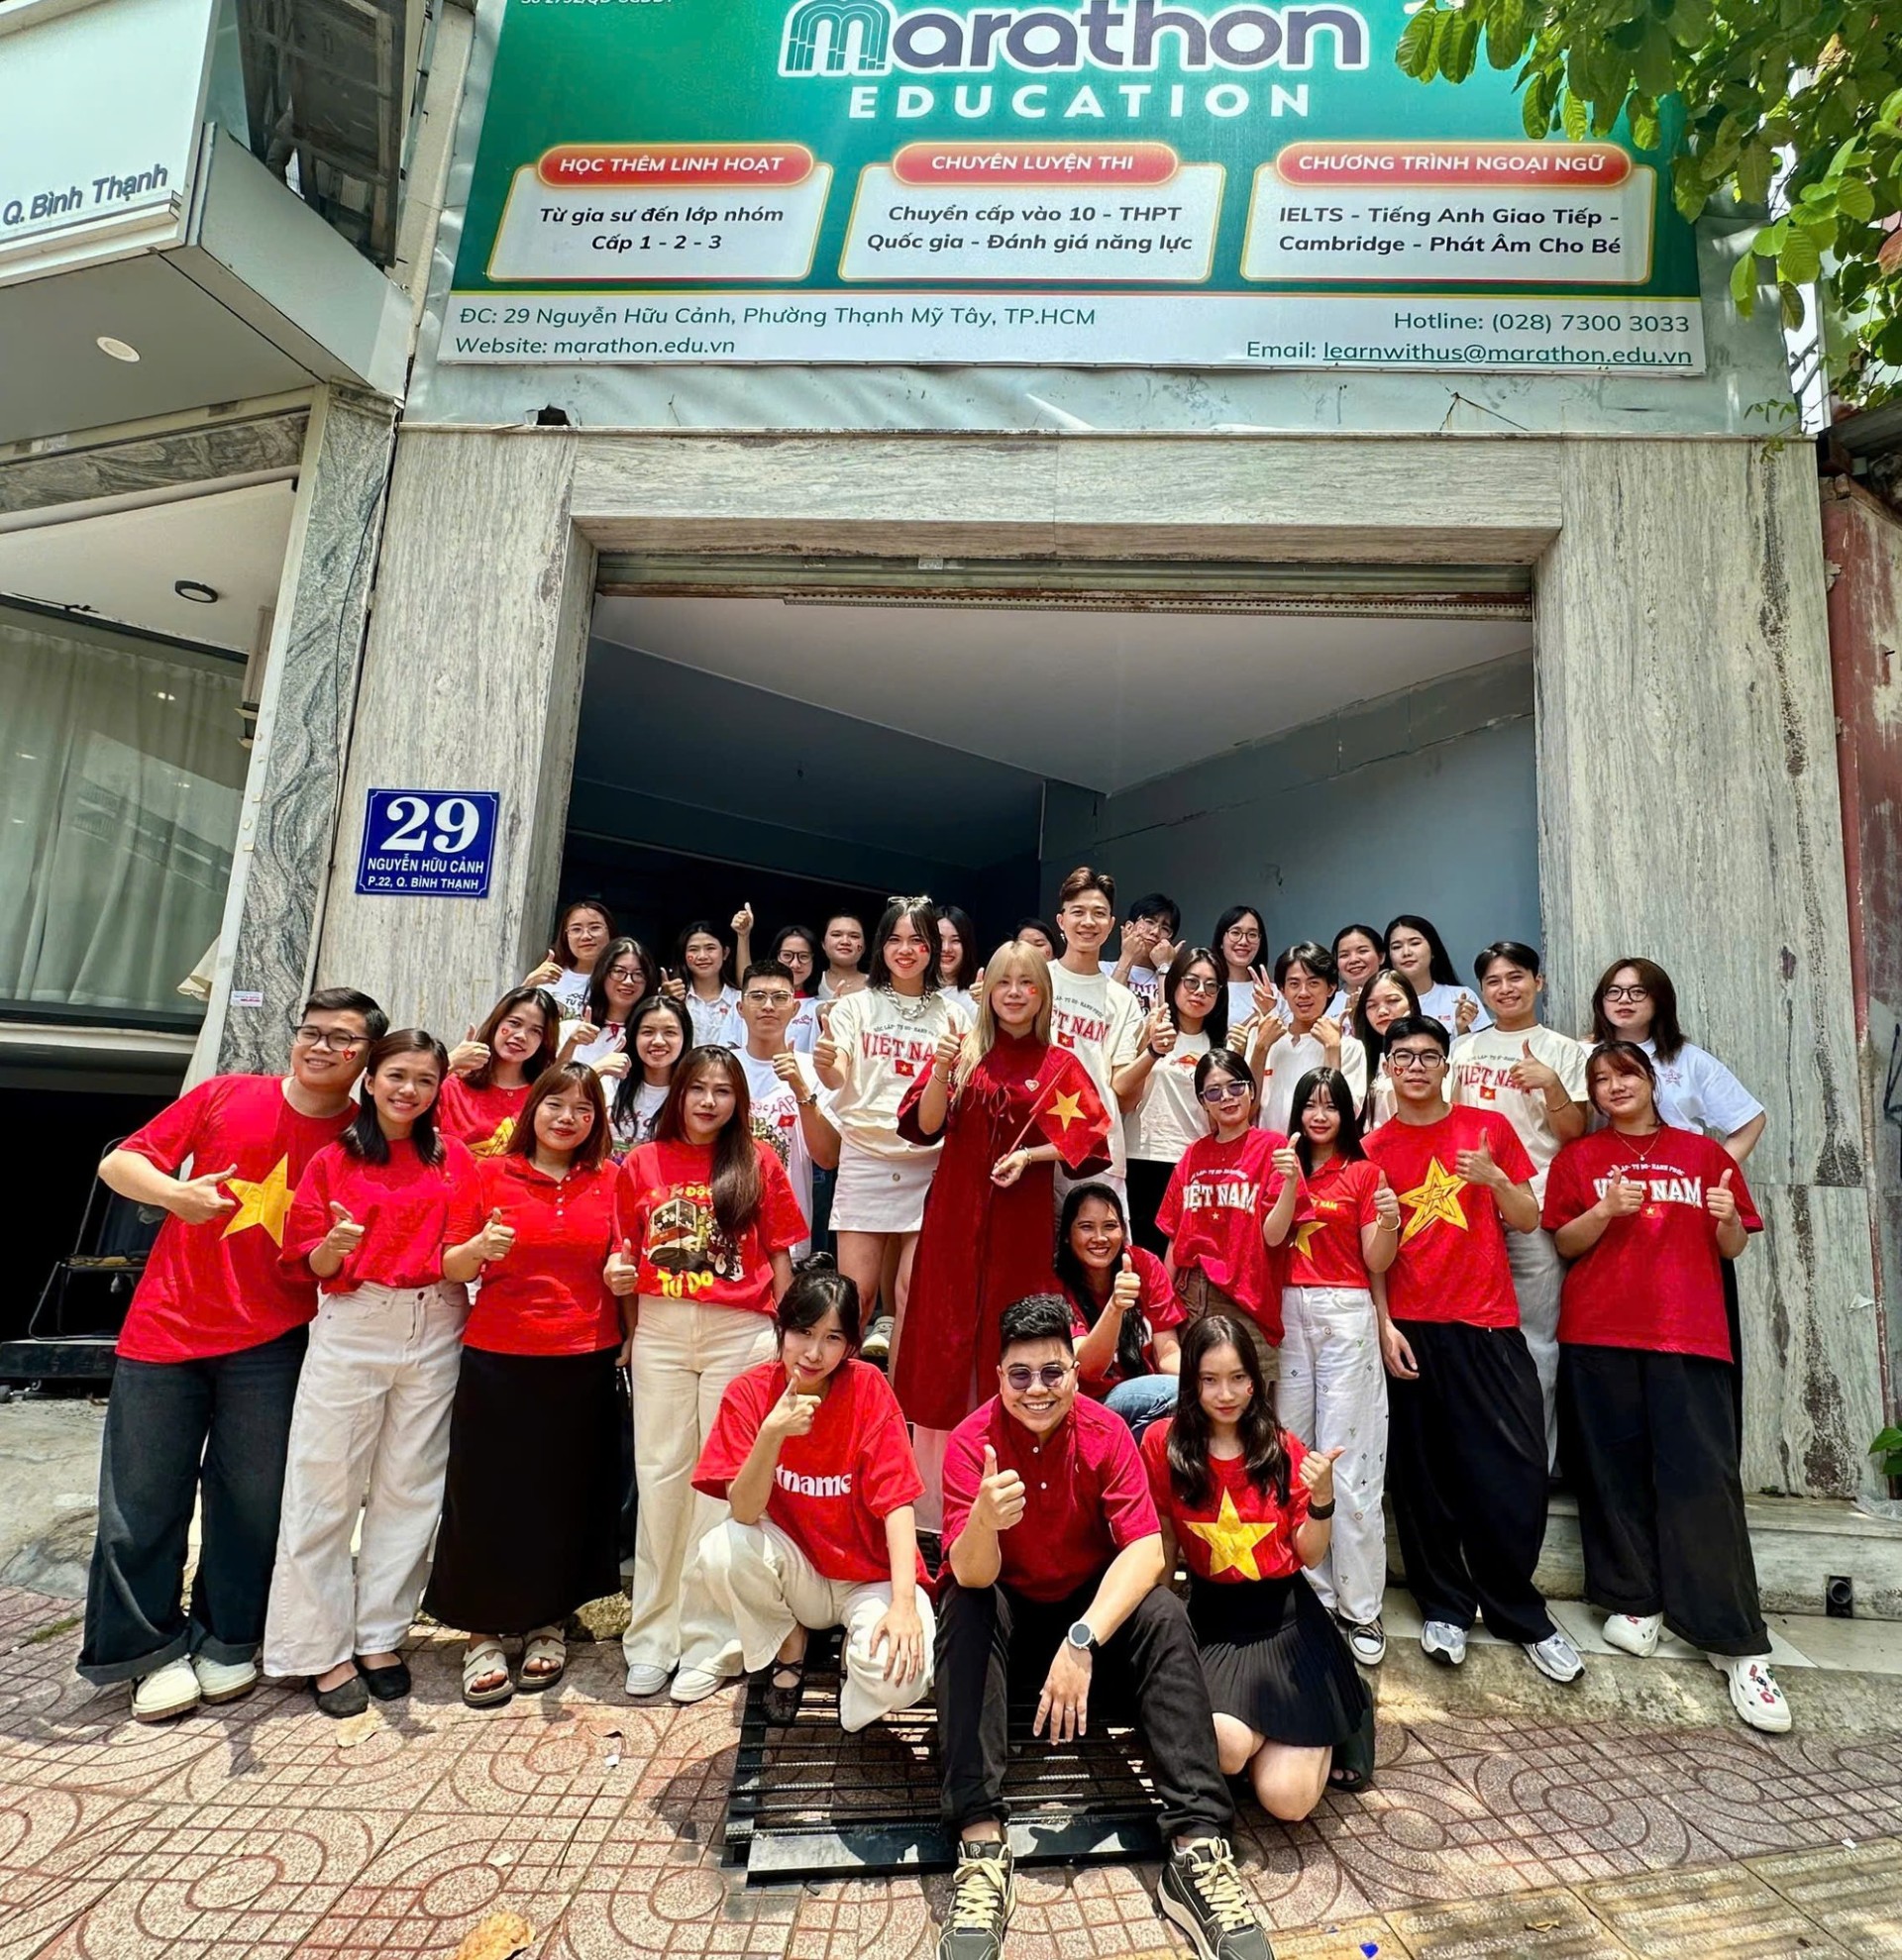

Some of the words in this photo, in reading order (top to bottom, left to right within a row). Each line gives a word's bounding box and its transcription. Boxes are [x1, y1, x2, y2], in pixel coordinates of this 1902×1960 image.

[781, 0, 1363, 73] marathon
[849, 83, 1310, 119] EDUCATION
[559, 156, 605, 175] HỌC
[609, 155, 667, 171] THÊM
[670, 156, 719, 172] LINH
[723, 155, 785, 173] HOẠT
[931, 154, 1018, 170] CHUYÊN
[1022, 154, 1093, 172] LUYỆN
[1099, 155, 1134, 170] THI
[1298, 155, 1395, 172] CHƯƠNG
[1400, 153, 1470, 171] TRÌNH
[1476, 156, 1549, 174] NGOẠI
[1553, 154, 1607, 172] NGỮ
[3, 200, 26, 226] Q.
[30, 185, 83, 221] Bình
[92, 162, 168, 204] Thạnh
[540, 206, 569, 223] Từ
[572, 207, 605, 227] gia
[609, 207, 639, 223] sư
[641, 206, 680, 223] đến
[684, 205, 719, 226] lớp
[724, 206, 785, 223] nhóm
[889, 204, 969, 225] Chuyển
[975, 204, 1015, 225] cấp
[1021, 204, 1062, 222] vào
[1069, 206, 1096, 222] 10
[1119, 206, 1183, 222] THPT
[1280, 207, 1343, 223] IELTS
[1368, 205, 1431, 227] Tiếng
[1437, 207, 1485, 224] Anh
[1492, 208, 1545, 225] Giao
[1552, 206, 1603, 229] Tiếp
[591, 233, 633, 254] Cấp
[639, 235, 651, 250] 1
[674, 235, 687, 250] 2
[708, 235, 722, 250] 3
[867, 232, 923, 253] Quốc
[928, 233, 964, 253] gia
[987, 233, 1047, 250] Đánh
[1053, 233, 1089, 254] giá
[1095, 234, 1153, 254] năng
[1159, 234, 1193, 254] lực
[1279, 236, 1405, 256] Cambridge
[1429, 237, 1485, 253] Phát
[1490, 233, 1532, 254] Âm
[1538, 237, 1584, 255] Cho
[1591, 237, 1622, 255] Bé
[460, 307, 497, 324] ĐC:
[502, 308, 531, 324] 29
[536, 306, 617, 329] Nguyễn
[624, 307, 669, 324] Hữu
[675, 306, 736, 326] Cảnh,
[743, 306, 827, 328] Phường
[834, 307, 903, 327] Thạnh
[911, 305, 944, 328] Mỹ
[950, 306, 997, 328] Tây,
[1004, 307, 1096, 326] TP.HCM
[1395, 312, 1483, 331] Hotline:
[1492, 313, 1552, 335] (028)
[1561, 314, 1622, 333] 7300
[1630, 316, 1690, 334] 3033
[456, 337, 548, 355] Website:
[554, 337, 735, 356] marathon.edu.vn
[1247, 341, 1317, 359] Email:
[1322, 342, 1694, 366] learnwithus@marathon.edu.vn
[380, 796, 479, 854] 29
[368, 853, 419, 873] NGUYỄN
[421, 857, 448, 874] HỮU
[450, 856, 484, 875] CẢNH
[368, 876, 393, 888] P.22,
[396, 877, 408, 888] Q.
[410, 875, 438, 889] BÌNH
[441, 877, 479, 891] THẠNH
[1070, 1014, 1110, 1043] NAM
[908, 1040, 935, 1061] NA
[1215, 1182, 1261, 1216] NAM
[1648, 1176, 1703, 1208] NAM
